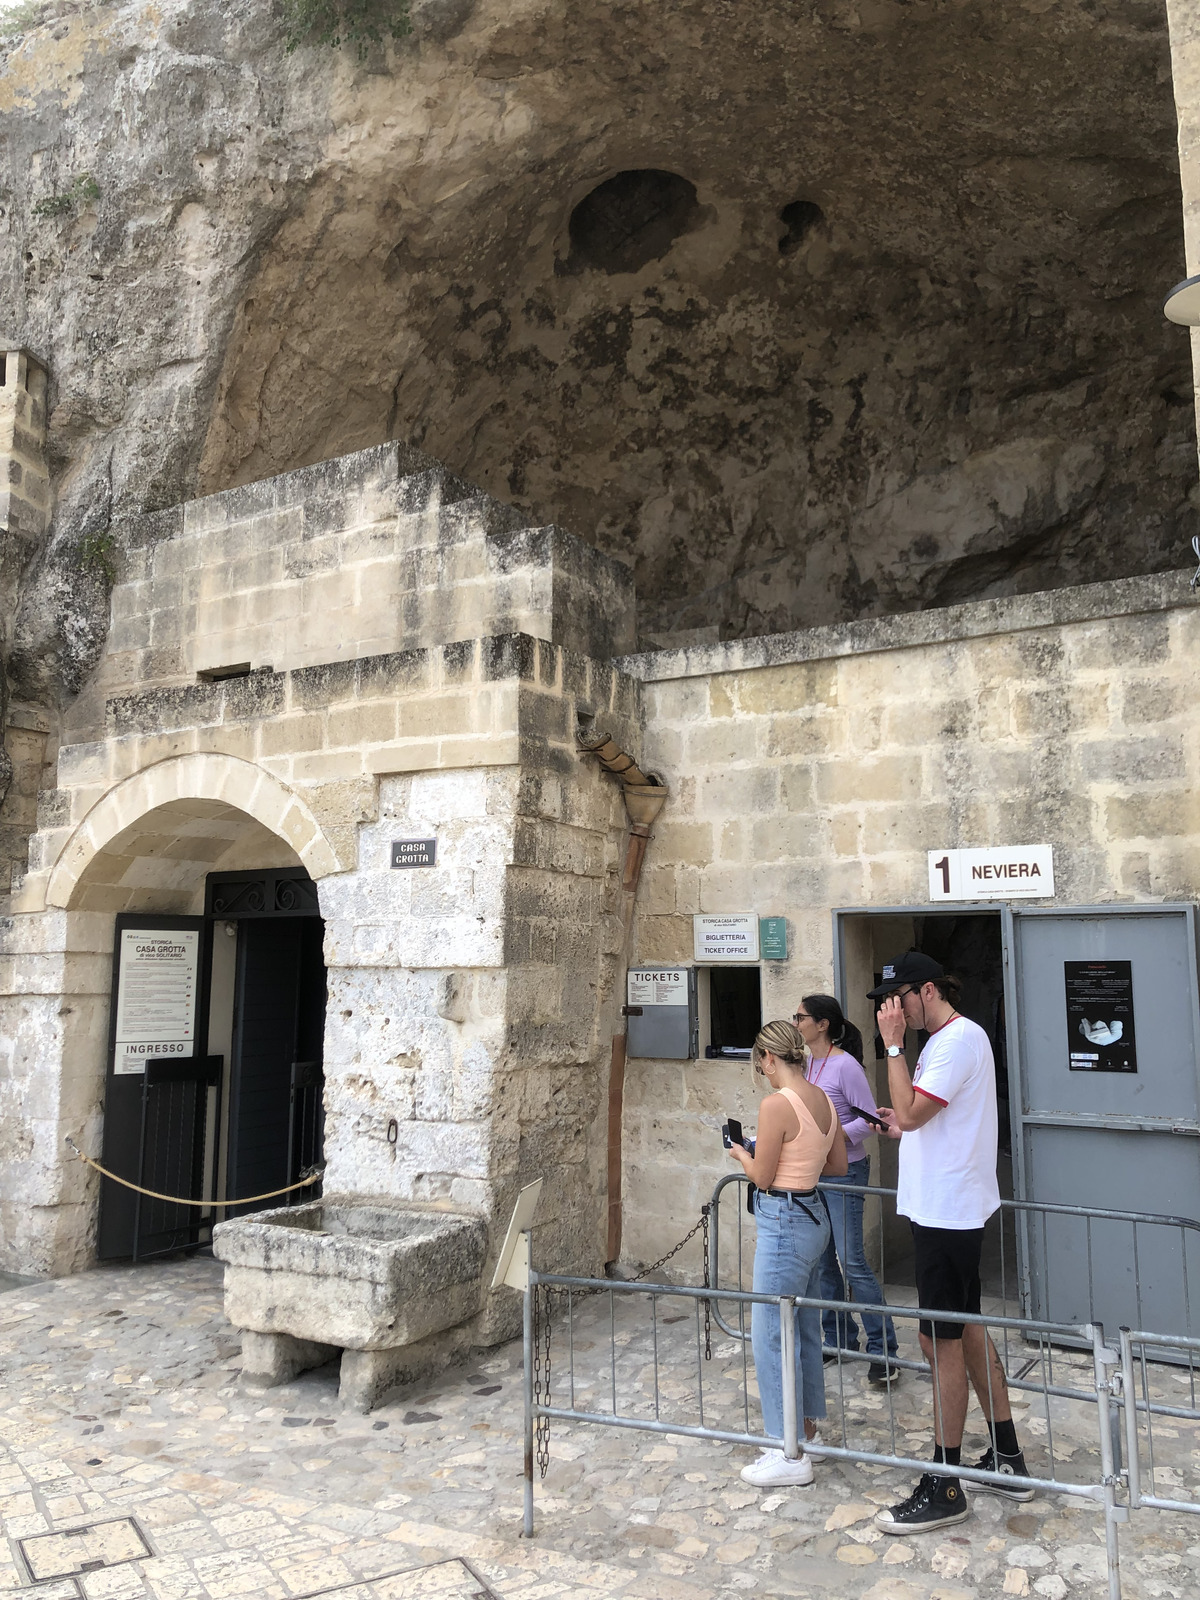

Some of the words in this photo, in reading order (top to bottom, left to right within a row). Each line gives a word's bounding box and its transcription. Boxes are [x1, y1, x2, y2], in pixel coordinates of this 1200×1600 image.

[401, 843, 425, 852] CASA
[395, 854, 429, 863] GROTTA
[935, 856, 950, 893] 1
[972, 862, 1041, 880] NEVIERA
[135, 945, 156, 953] CASA
[157, 945, 187, 953] GROTTA
[634, 973, 680, 982] TICKETS
[126, 1043, 184, 1054] INGRESSO
